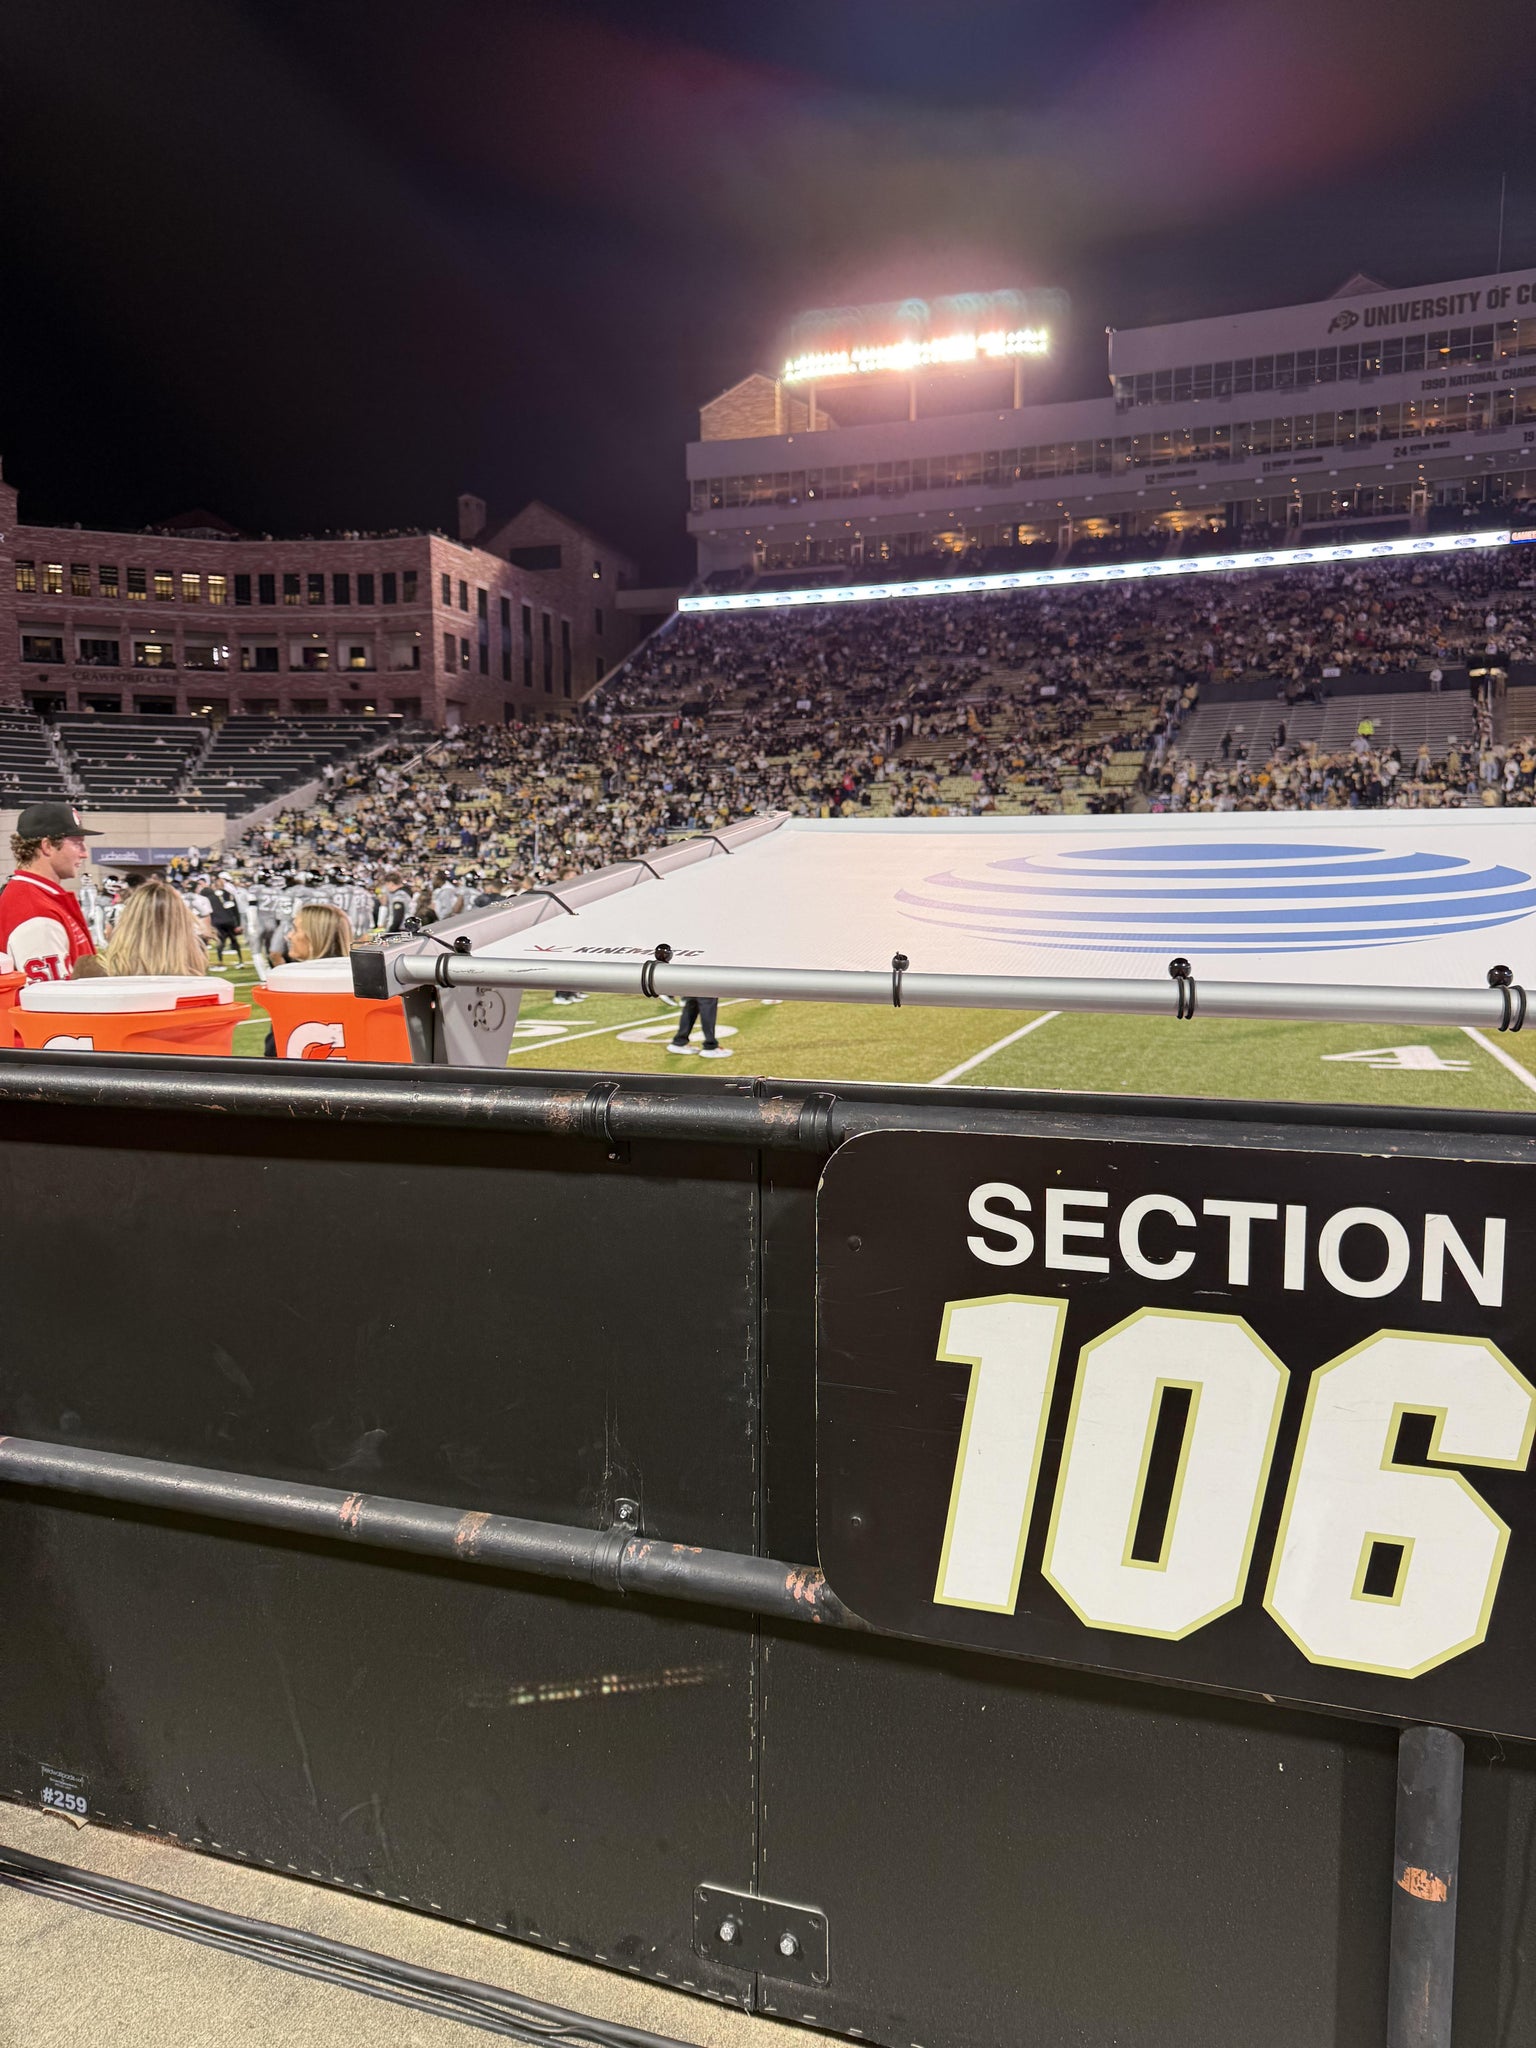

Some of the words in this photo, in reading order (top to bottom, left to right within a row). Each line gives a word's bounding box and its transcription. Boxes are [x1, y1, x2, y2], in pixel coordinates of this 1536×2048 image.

[1363, 290, 1481, 328] UNIVERSITY
[1486, 286, 1512, 310] OF
[1421, 377, 1446, 391] 1990
[1449, 371, 1498, 388] NATIONAL
[258, 894, 280, 912] 27
[966, 1182, 1507, 1308] SECTION
[932, 1293, 1536, 1680] 106
[42, 1786, 87, 1814] #259
